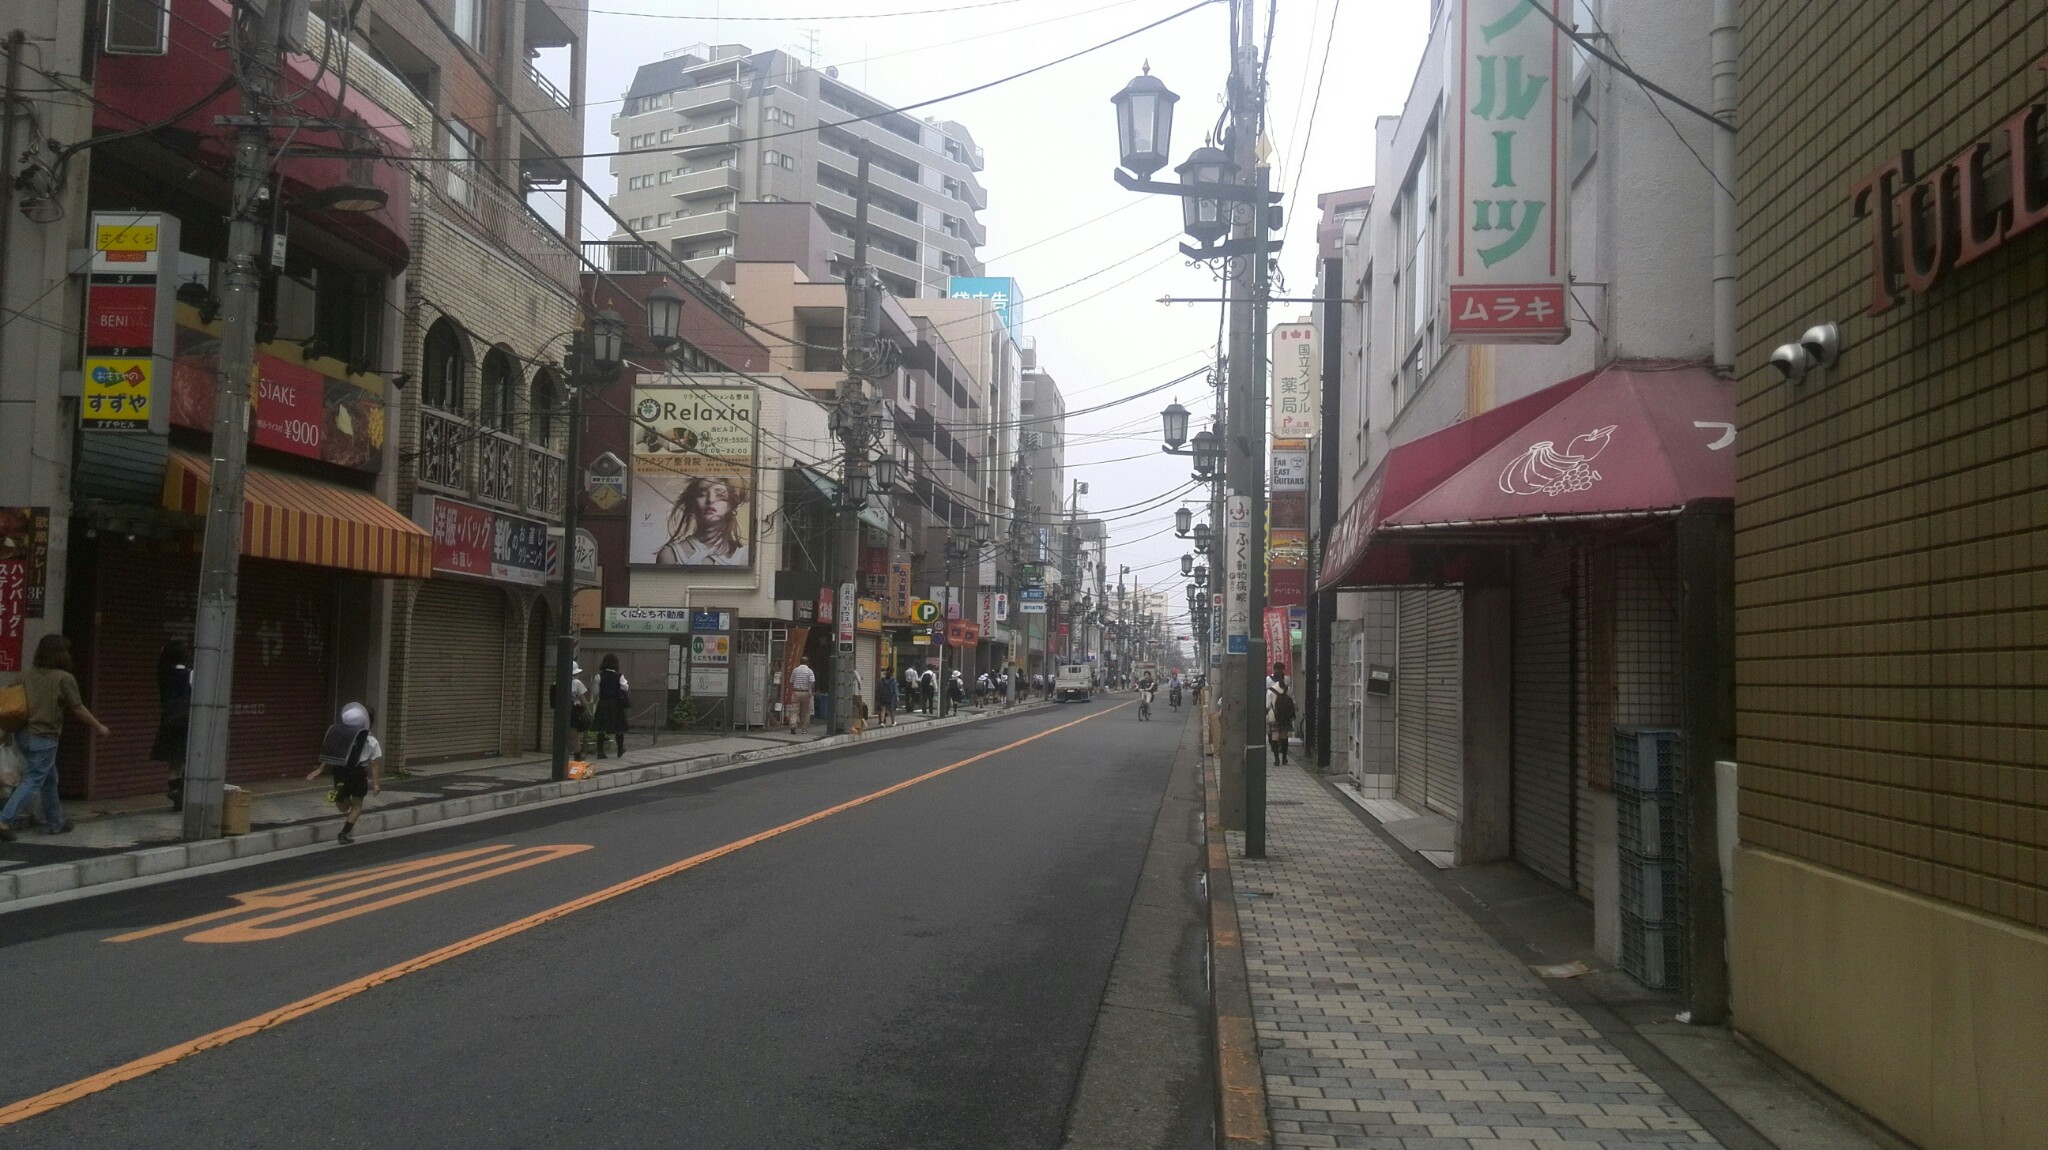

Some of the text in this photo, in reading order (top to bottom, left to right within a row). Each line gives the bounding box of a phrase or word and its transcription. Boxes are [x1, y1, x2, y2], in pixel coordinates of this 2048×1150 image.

[118, 275, 133, 284] 3F
[1459, 294, 1555, 323] ムラキ
[113, 347, 128, 356] 2F
[96, 371, 138, 381] おもちゃの
[1298, 343, 1311, 414] 国立メイプル
[260, 378, 296, 407] STAKE
[1281, 376, 1298, 414] 薬局
[88, 393, 147, 413] すずや
[664, 403, 749, 421] Relaxia
[97, 421, 135, 429] すずやビル
[284, 419, 319, 447] ¥900
[1273, 457, 1287, 467] FAR
[1273, 467, 1291, 476] EAST
[1273, 476, 1305, 485] GUITARS
[434, 504, 492, 550] 洋服・バッグ
[452, 551, 473, 568] お直し
[518, 547, 544, 566] クリーニング
[1236, 532, 1249, 603] ふく動物病院
[27, 587, 45, 600] 3F
[620, 609, 686, 620] くにたち不動産
[923, 605, 936, 620] P
